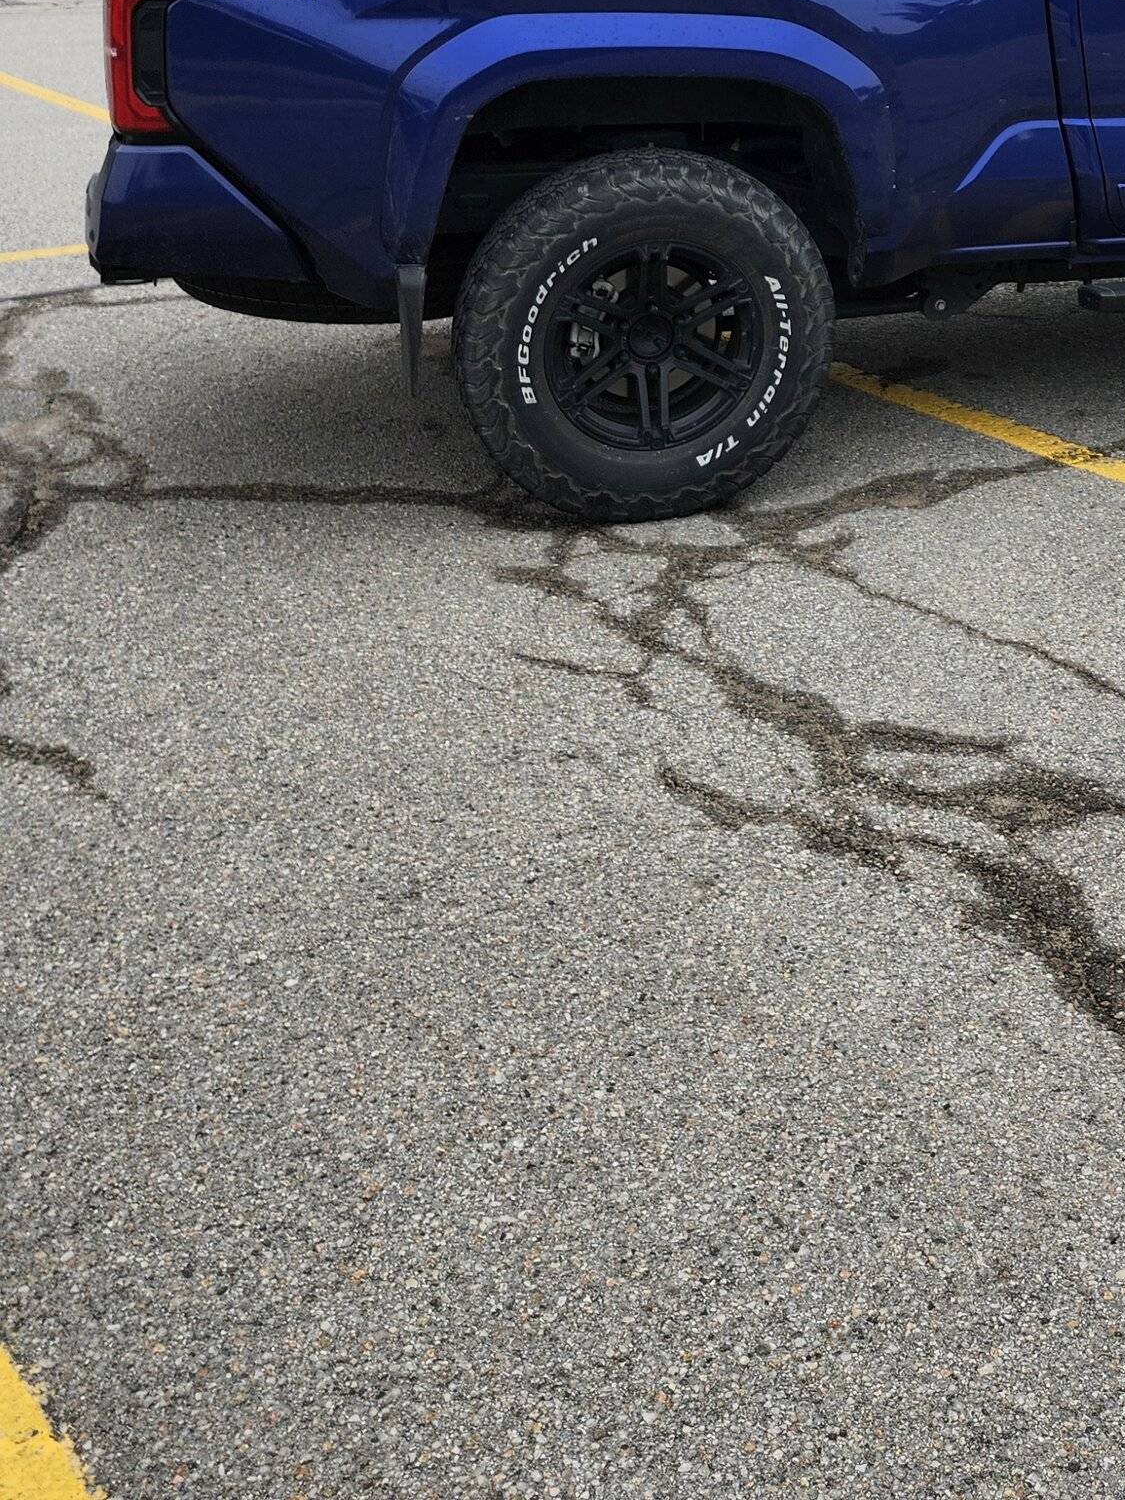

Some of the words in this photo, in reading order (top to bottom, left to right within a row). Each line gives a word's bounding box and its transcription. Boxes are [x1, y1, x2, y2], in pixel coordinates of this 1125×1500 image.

[517, 236, 599, 405] BFGoodrich
[745, 274, 793, 428] All-Terrain
[695, 434, 740, 467] T/A
